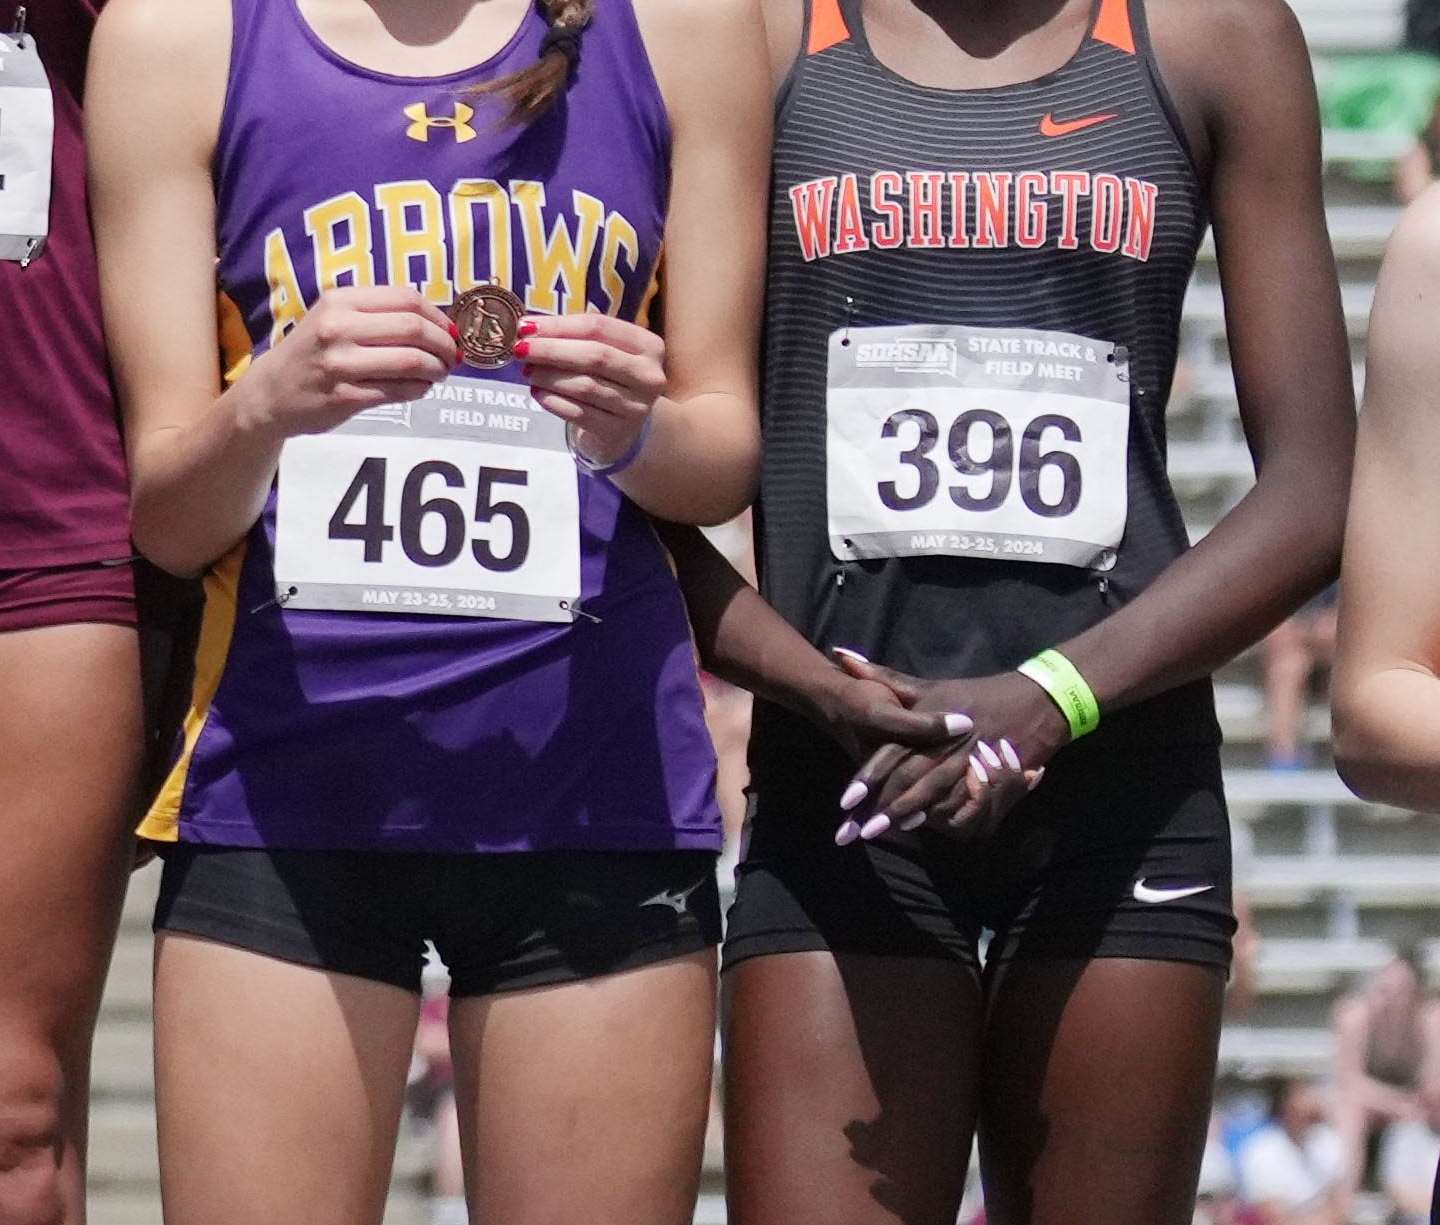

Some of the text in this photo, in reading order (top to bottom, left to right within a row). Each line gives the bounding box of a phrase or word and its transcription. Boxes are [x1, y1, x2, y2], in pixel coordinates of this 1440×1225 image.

[788, 171, 1158, 262] WASHINGTON
[264, 178, 639, 350] ARROWS
[855, 343, 948, 363] SDHSAA
[969, 336, 1097, 364] STATE TRACK &
[985, 360, 1084, 381] FIELD MEET
[423, 385, 473, 403] STATE
[477, 388, 527, 409] TRACK
[439, 408, 531, 432] FIELD MEET
[877, 409, 1082, 518] 396
[327, 456, 530, 572] 465
[910, 534, 1044, 555] MAY 23-25, 2024
[362, 590, 496, 610] MAY 23-25, 2024
